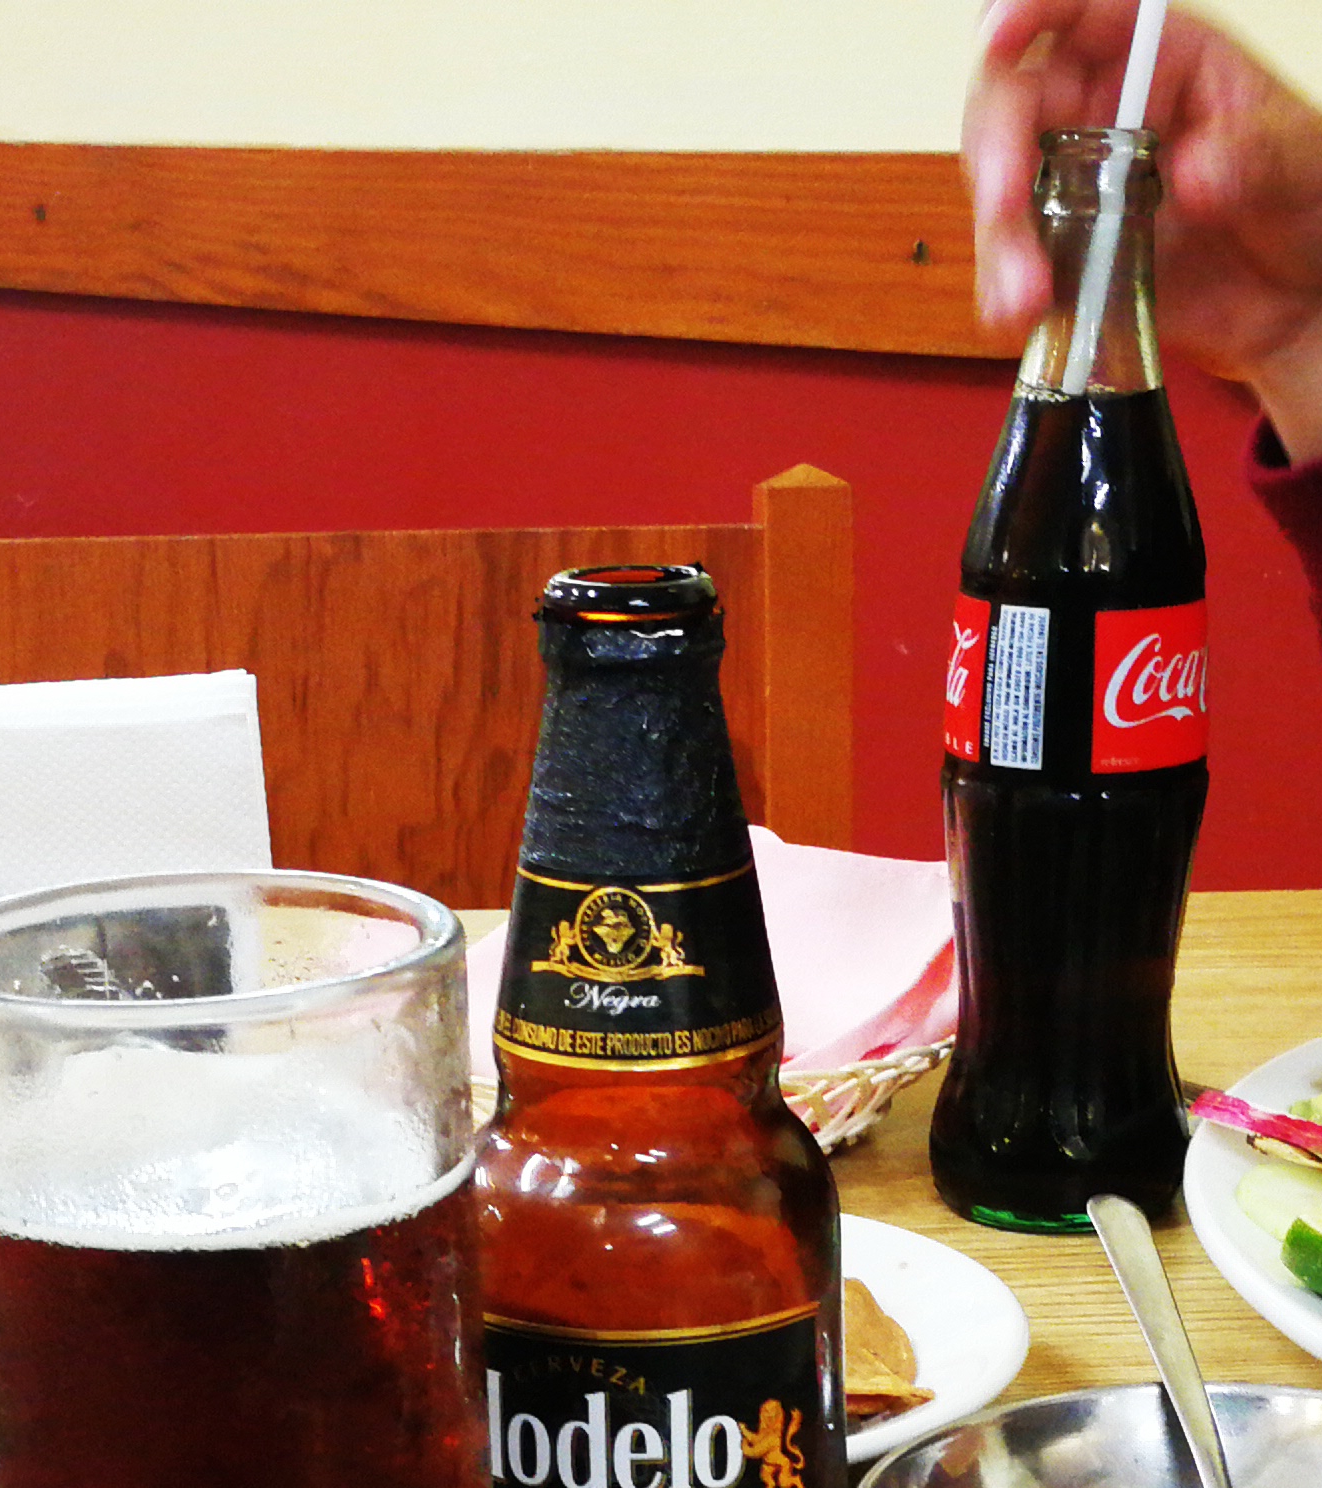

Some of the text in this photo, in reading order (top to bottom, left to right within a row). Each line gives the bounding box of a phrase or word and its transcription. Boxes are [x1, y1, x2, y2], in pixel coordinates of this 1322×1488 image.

[563, 981, 662, 1016] Negra
[558, 1028, 575, 1053] DE
[576, 1031, 605, 1055] ESTE
[606, 1031, 673, 1057] PRODUCTO
[674, 1029, 691, 1055] ES
